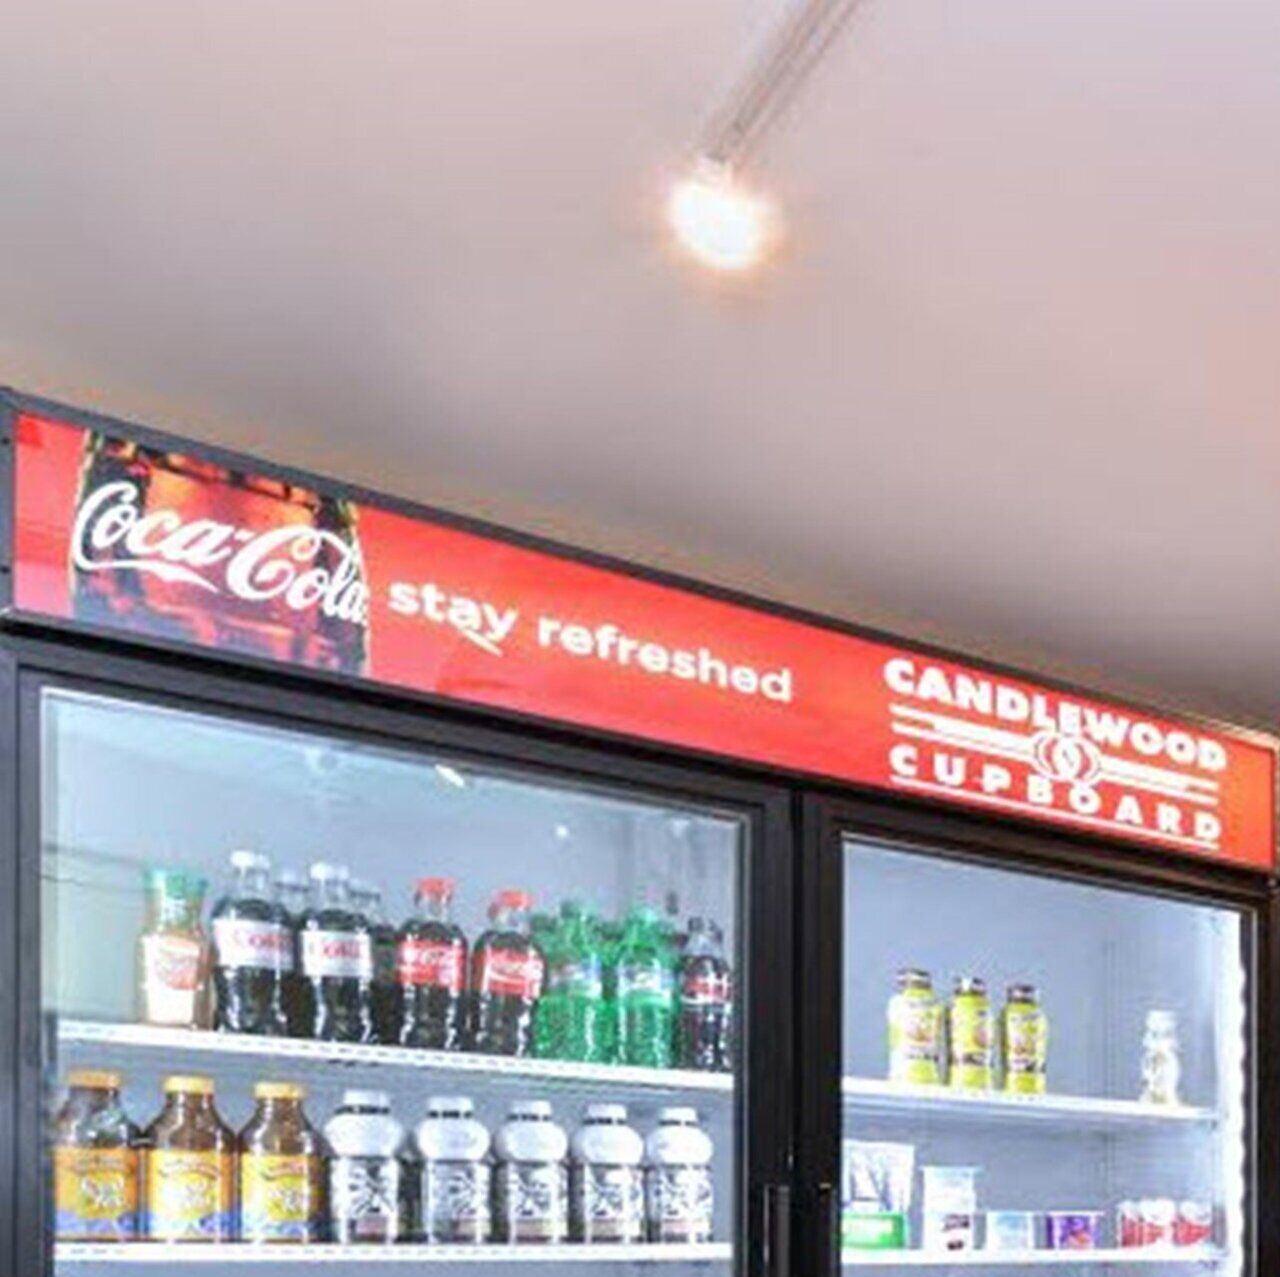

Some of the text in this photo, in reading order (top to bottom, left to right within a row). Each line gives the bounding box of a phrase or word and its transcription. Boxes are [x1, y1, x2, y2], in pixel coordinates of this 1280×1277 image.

[73, 480, 371, 627] Coca-Cola
[387, 580, 794, 702] stay refreshed
[883, 656, 1228, 773] CANDLEWOOD
[888, 743, 1223, 842] CUPBOARD
